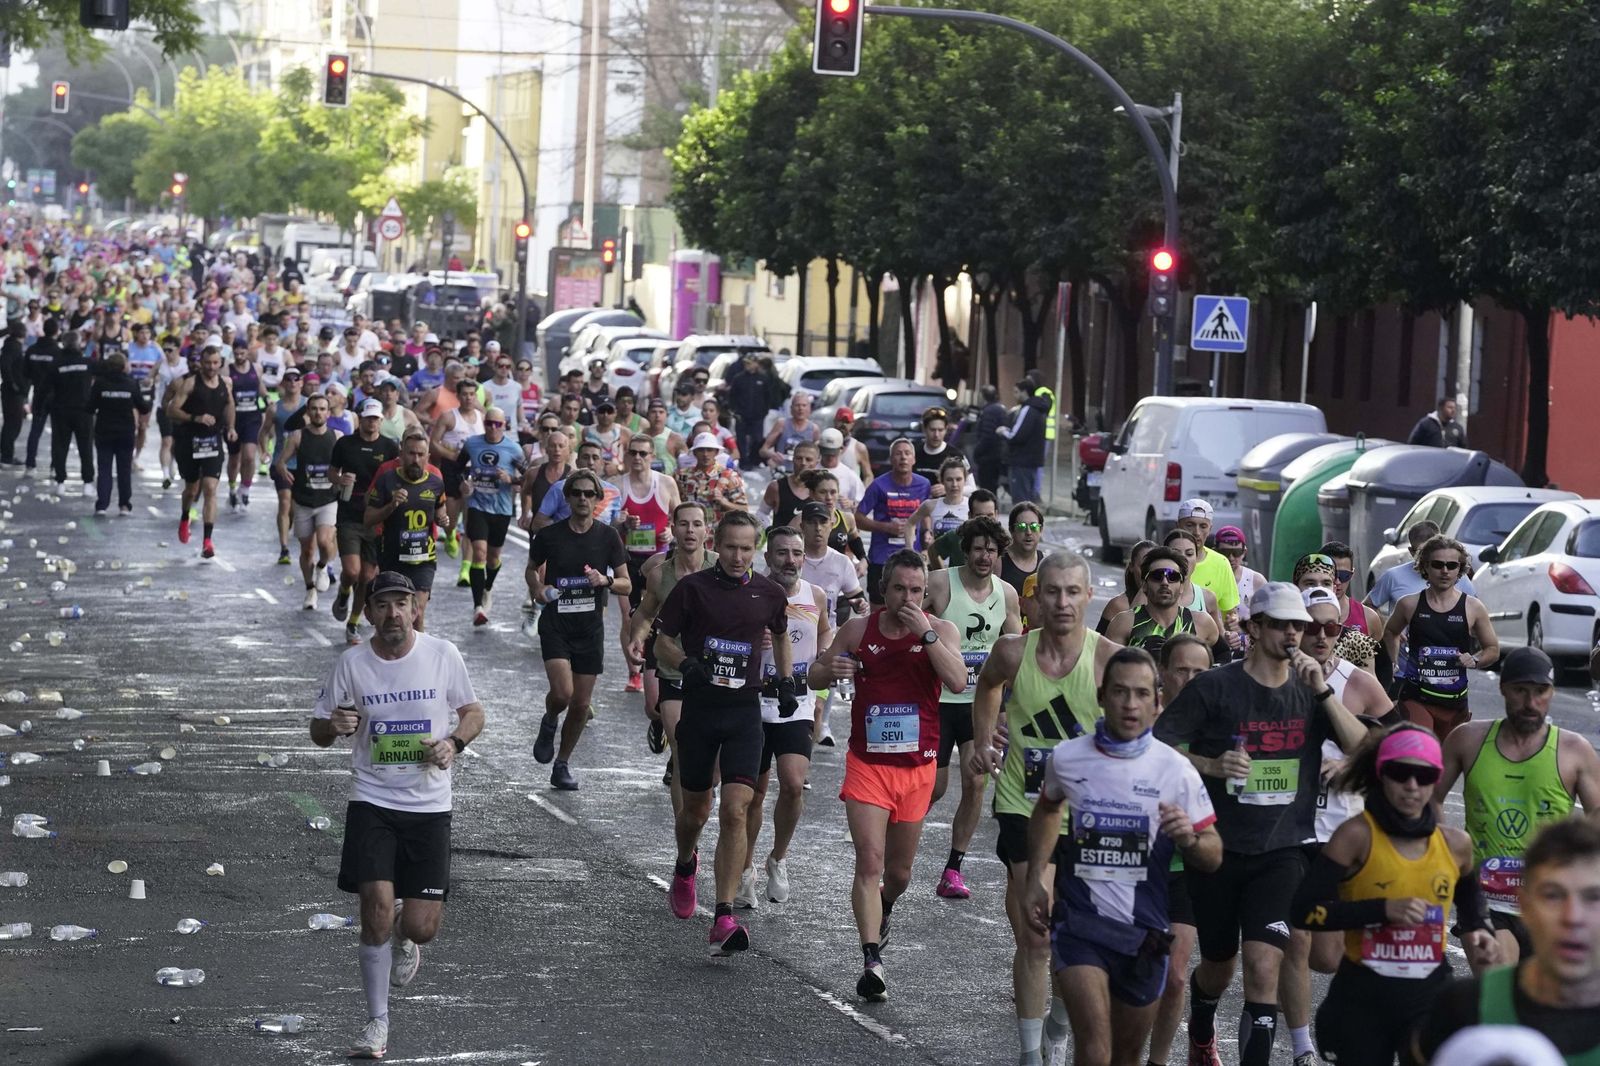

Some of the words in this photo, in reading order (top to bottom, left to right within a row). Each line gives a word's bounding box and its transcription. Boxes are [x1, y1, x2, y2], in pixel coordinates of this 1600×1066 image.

[404, 509, 427, 530] 10
[720, 642, 747, 652] ZURICH
[713, 663, 737, 677] YEYU
[361, 688, 436, 706] INVINCIBLE
[882, 705, 913, 714] ZURICH
[390, 723, 425, 732] ZURICH
[884, 721, 901, 729] 8740
[1240, 718, 1305, 732] LEGALIZE
[881, 731, 904, 741] SEVI
[391, 740, 410, 748] 3402
[379, 750, 424, 762] ARNAUD
[1262, 766, 1282, 775] 3355
[1254, 778, 1288, 792] TITOU
[1100, 817, 1141, 829] ZURICH
[1099, 837, 1122, 848] 4750
[1080, 848, 1142, 866] ESTEBAN
[1370, 943, 1435, 960] JULIANA
